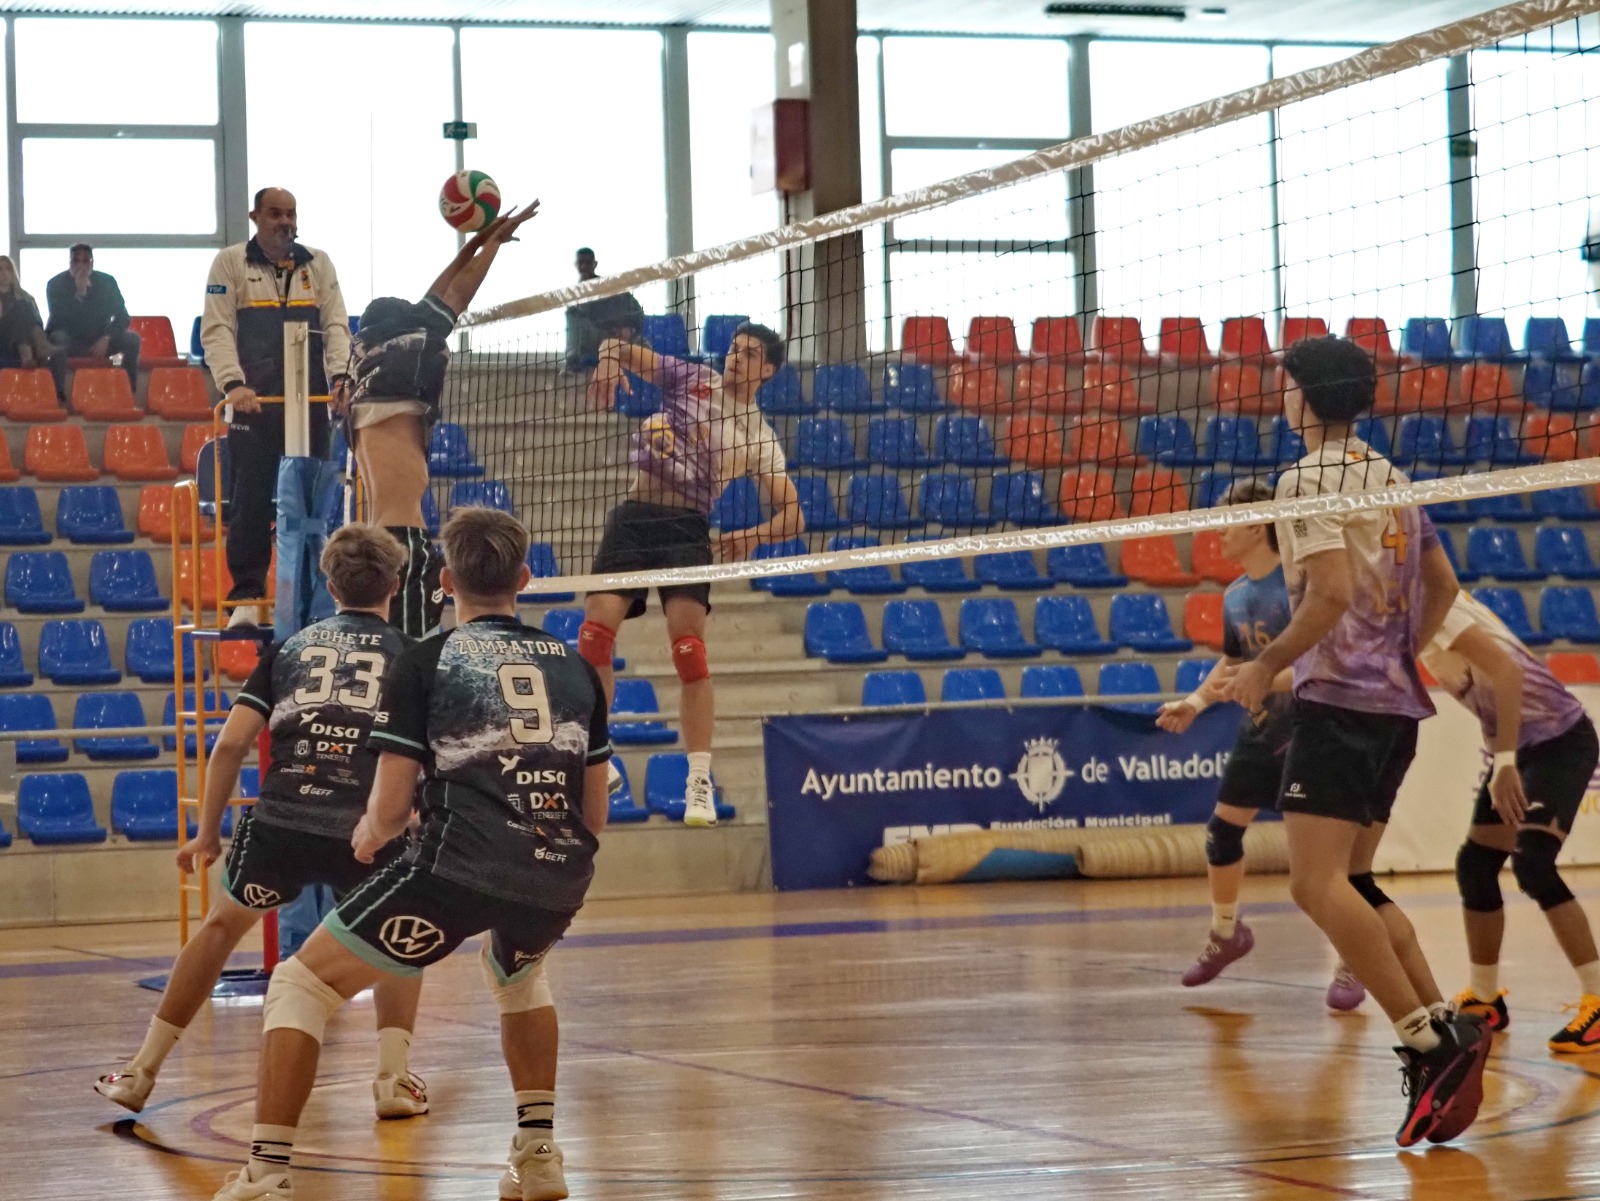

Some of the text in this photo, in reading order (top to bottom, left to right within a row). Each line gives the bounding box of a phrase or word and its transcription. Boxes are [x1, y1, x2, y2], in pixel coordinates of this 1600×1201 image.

[308, 629, 382, 646] COHETE
[455, 639, 567, 658] ZOMPATORI
[294, 645, 386, 711] 33
[496, 662, 555, 745] 9
[316, 741, 358, 755] DXT
[316, 753, 351, 763] TENERIFE
[801, 762, 1002, 799] Ayuntamiento
[1082, 757, 1108, 783] de
[531, 811, 567, 820] TENERIFE
[1084, 813, 1171, 828] Municipal
